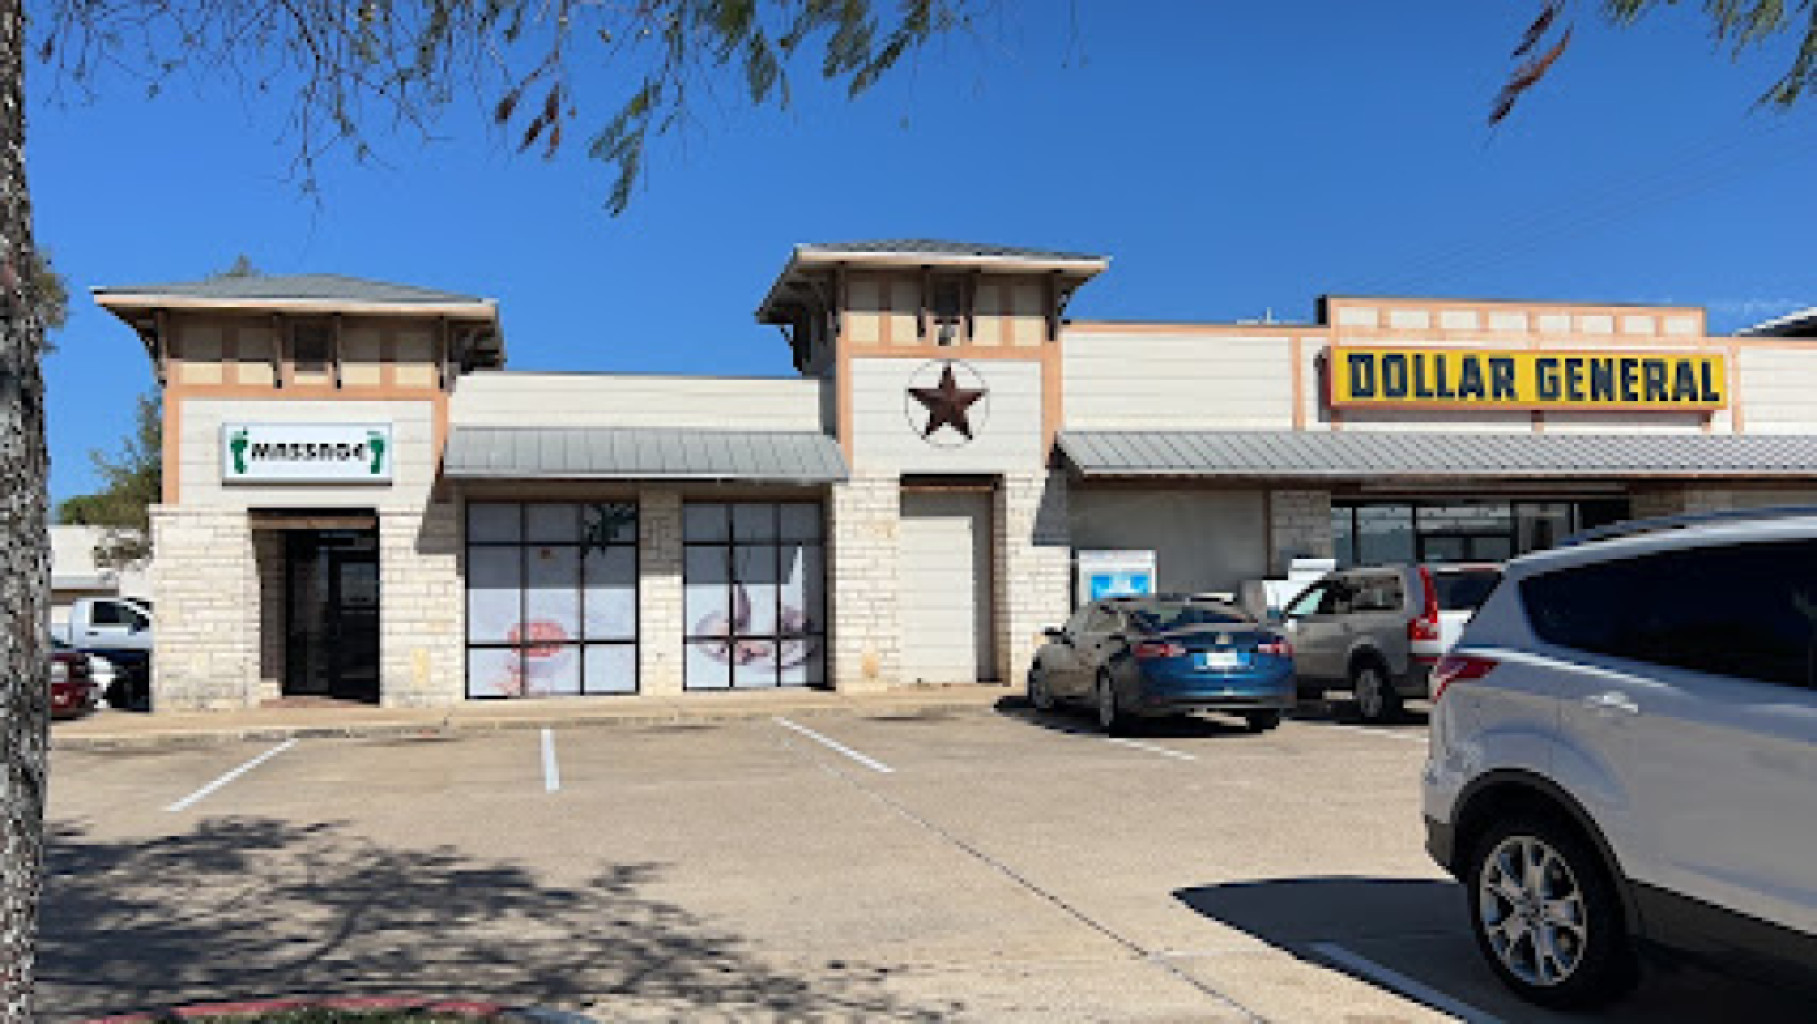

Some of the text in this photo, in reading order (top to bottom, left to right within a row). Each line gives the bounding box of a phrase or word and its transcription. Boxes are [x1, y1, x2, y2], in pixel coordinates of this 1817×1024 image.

[1347, 353, 1720, 402] DOLLAR GENERAL
[251, 443, 367, 461] MASSAGE
